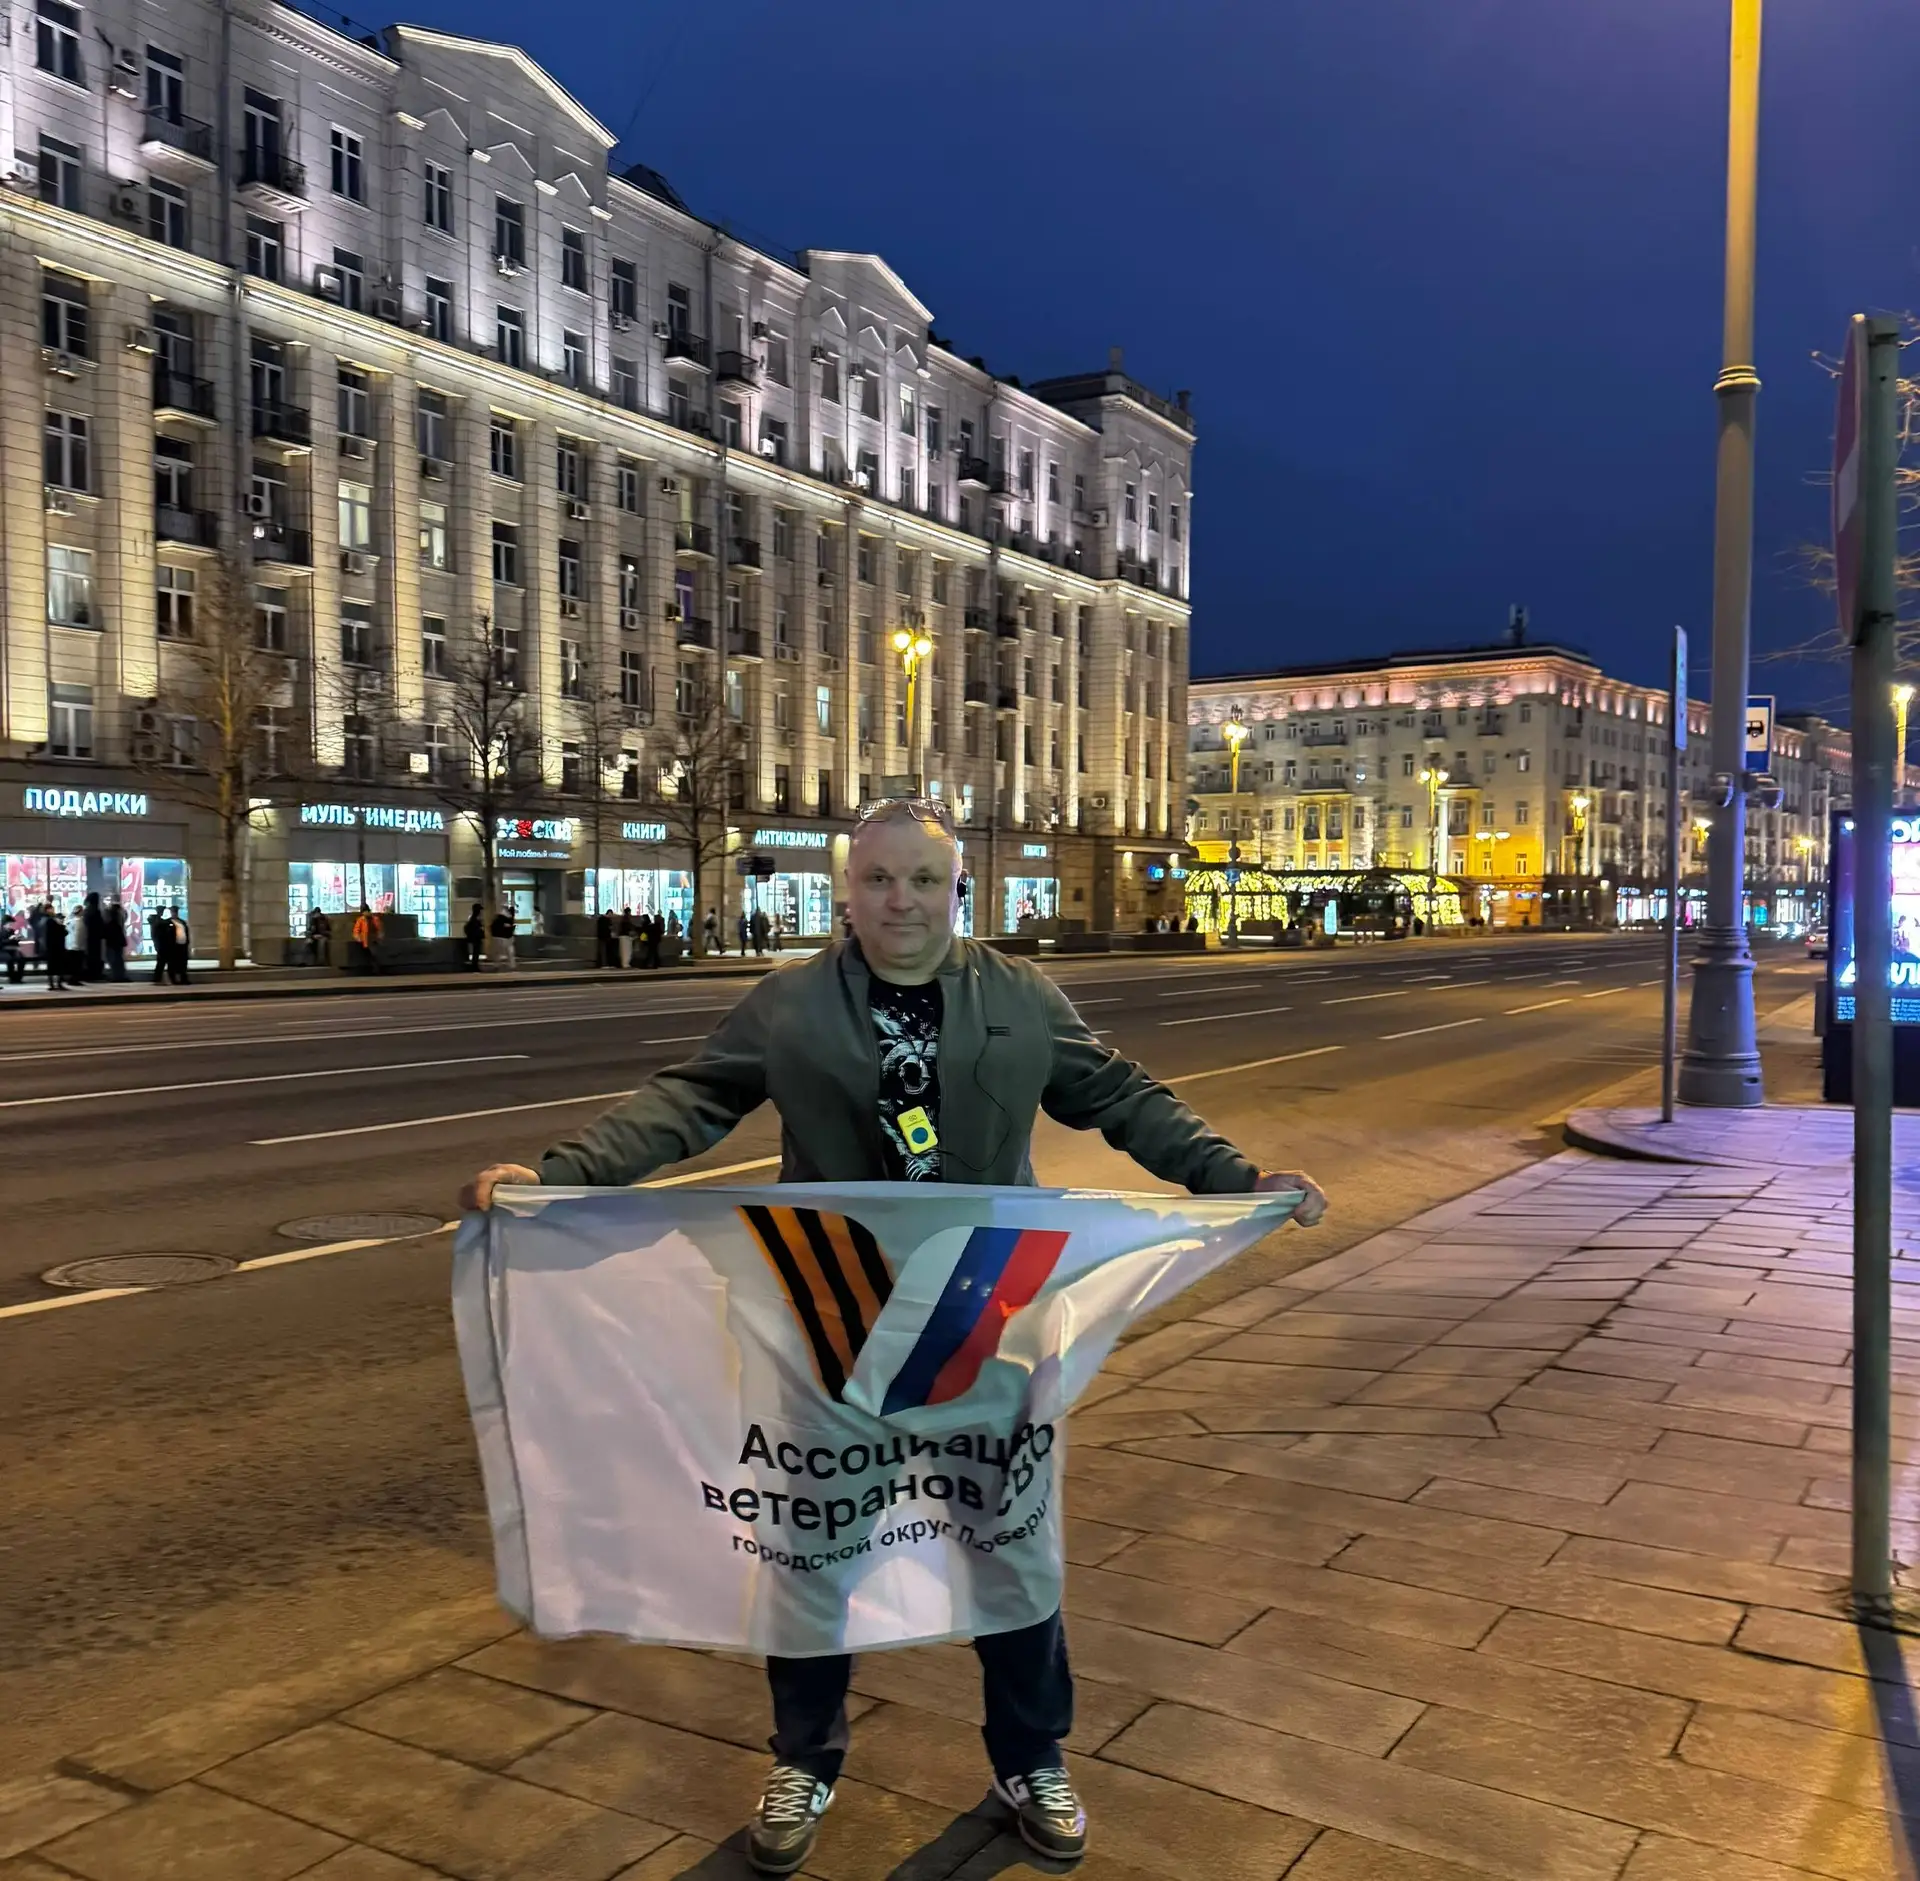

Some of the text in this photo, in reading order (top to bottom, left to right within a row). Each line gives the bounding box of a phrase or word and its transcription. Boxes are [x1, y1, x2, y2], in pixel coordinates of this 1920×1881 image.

[25, 787, 148, 817] ПОДАРКИ
[622, 822, 667, 842] КНИГИ
[752, 828, 829, 847] АНТИКВАРИАТ
[497, 848, 516, 858] Мой
[701, 1481, 983, 1541] ветеранов
[731, 1534, 872, 1573] городской
[881, 1518, 953, 1548] округ
